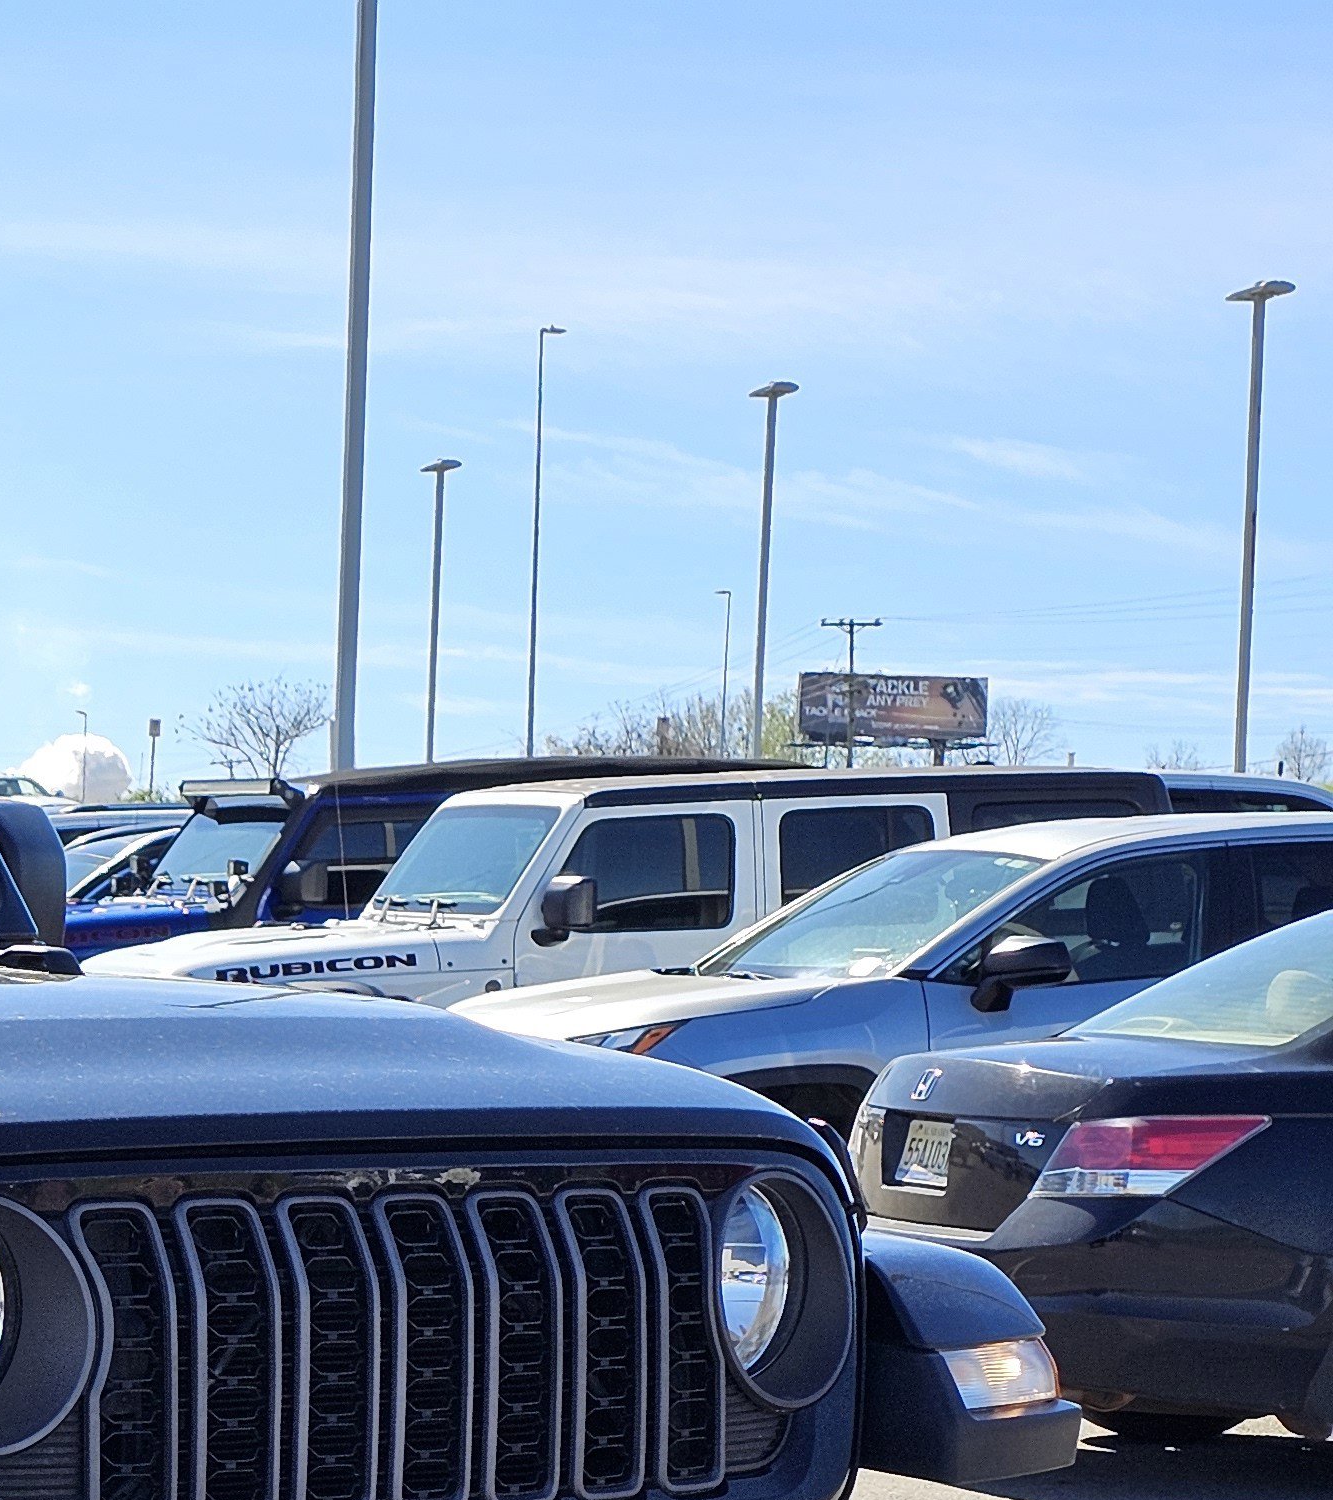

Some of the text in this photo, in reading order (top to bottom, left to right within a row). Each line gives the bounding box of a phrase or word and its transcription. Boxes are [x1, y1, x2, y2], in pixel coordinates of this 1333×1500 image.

[868, 678, 930, 696] TACKLE
[866, 694, 930, 708] ANY PREY
[216, 953, 417, 984] RUBICON
[1015, 1131, 1046, 1147] V6
